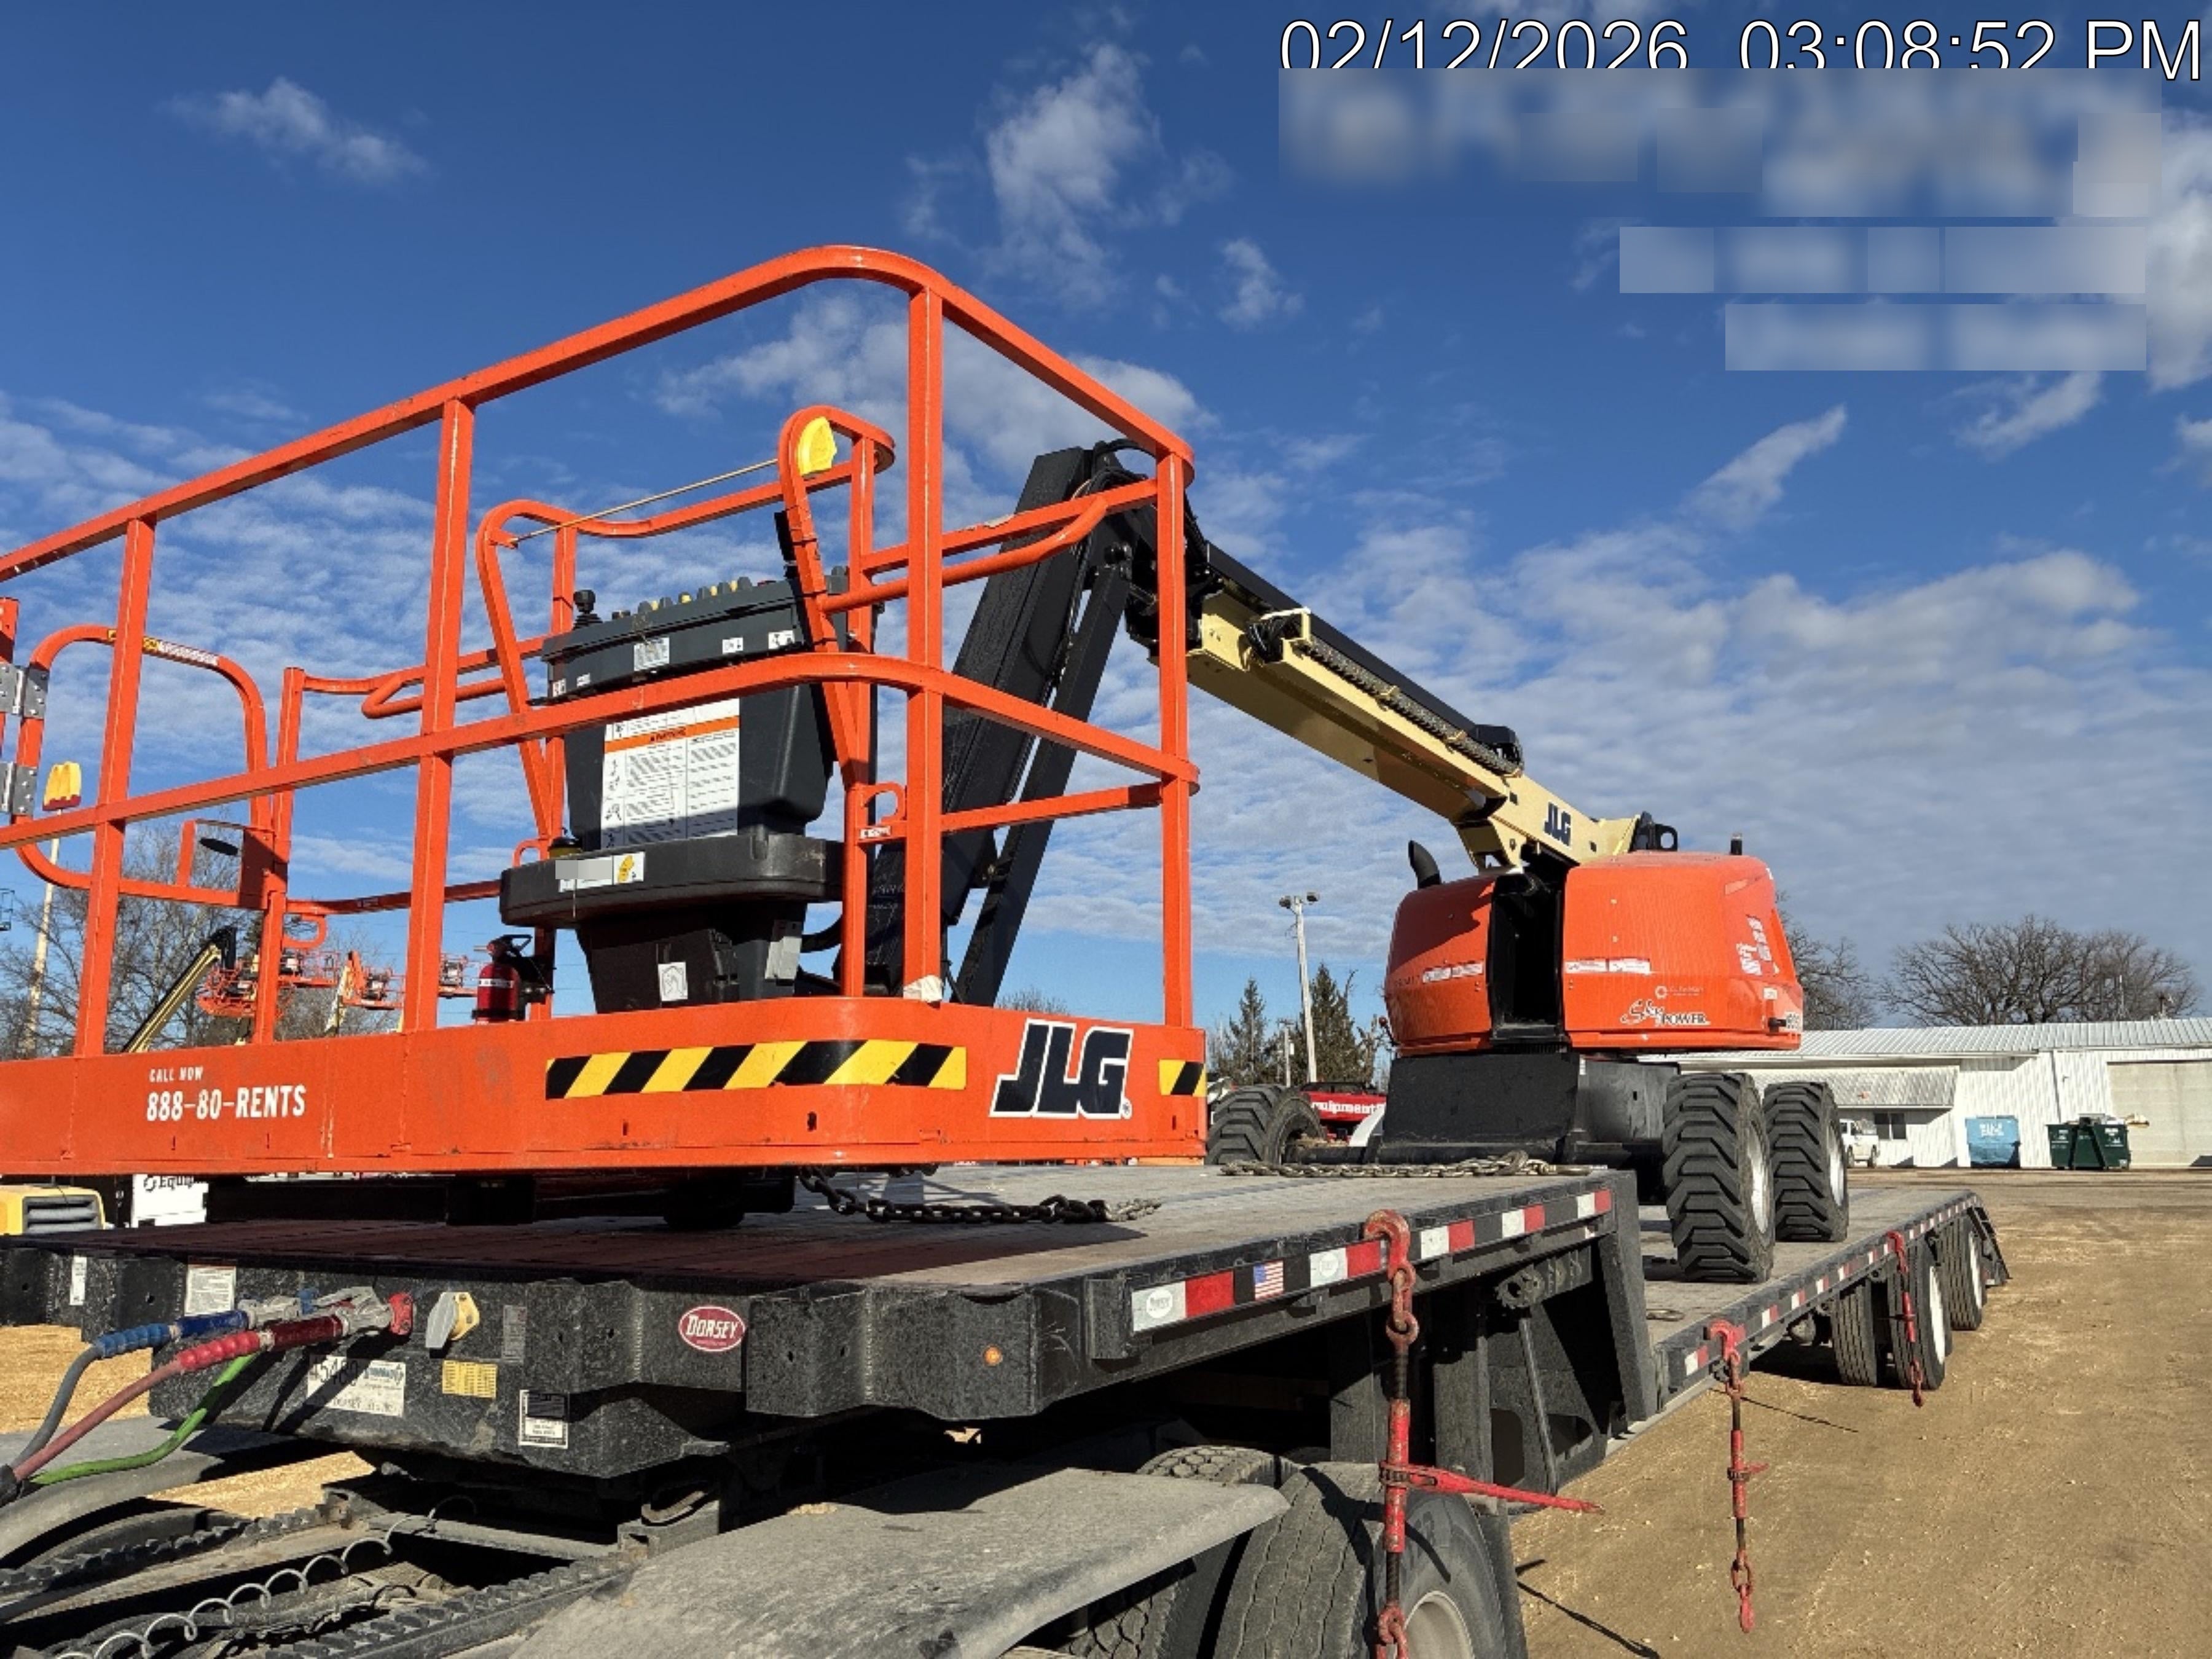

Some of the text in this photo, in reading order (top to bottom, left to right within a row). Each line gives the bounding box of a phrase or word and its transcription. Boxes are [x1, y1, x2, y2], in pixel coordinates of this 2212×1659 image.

[1543, 801, 1572, 847] JLG
[149, 1066, 203, 1083] CALL NOW
[990, 1018, 1134, 1119] JLG
[146, 1084, 306, 1121] 888-80-RENTS
[686, 1314, 739, 1339] DORSEY
